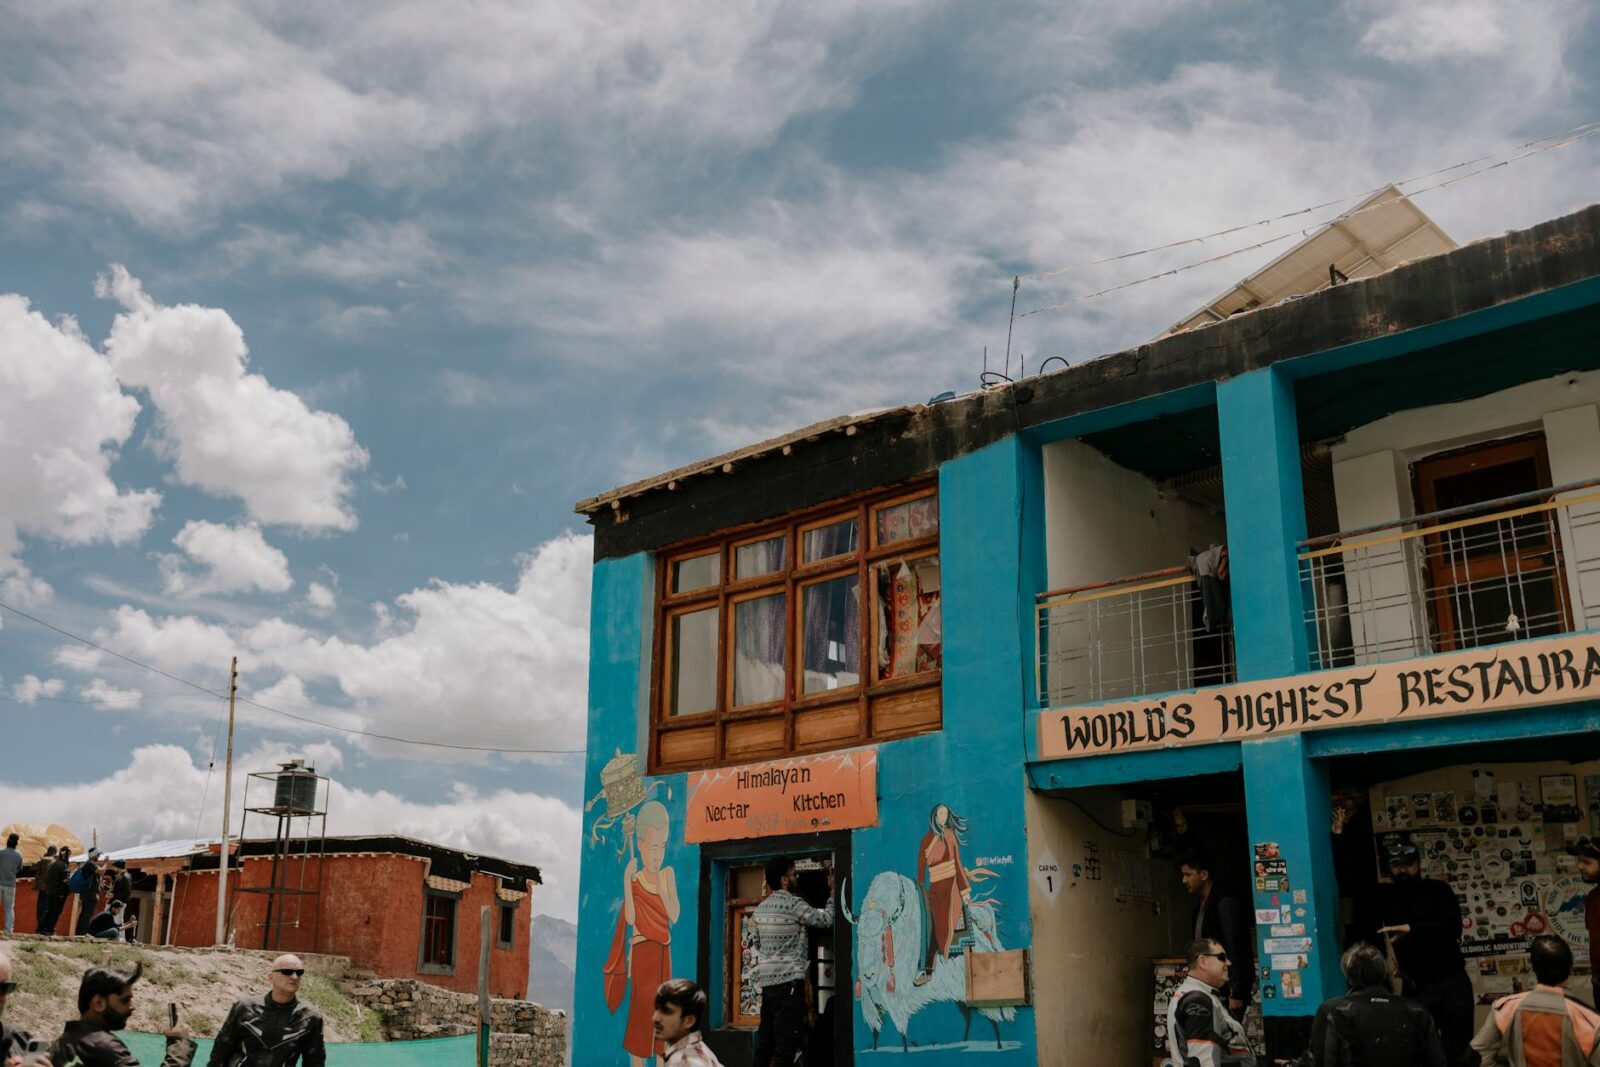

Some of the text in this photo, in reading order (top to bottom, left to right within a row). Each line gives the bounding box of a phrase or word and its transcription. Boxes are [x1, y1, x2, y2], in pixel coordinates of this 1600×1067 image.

[1060, 701, 1195, 750] WORLD'S
[1214, 670, 1377, 737] HIGHEST
[736, 767, 811, 795] Himalayan
[705, 792, 846, 822] Nectar Kitchen
[1046, 875, 1053, 893] 1
